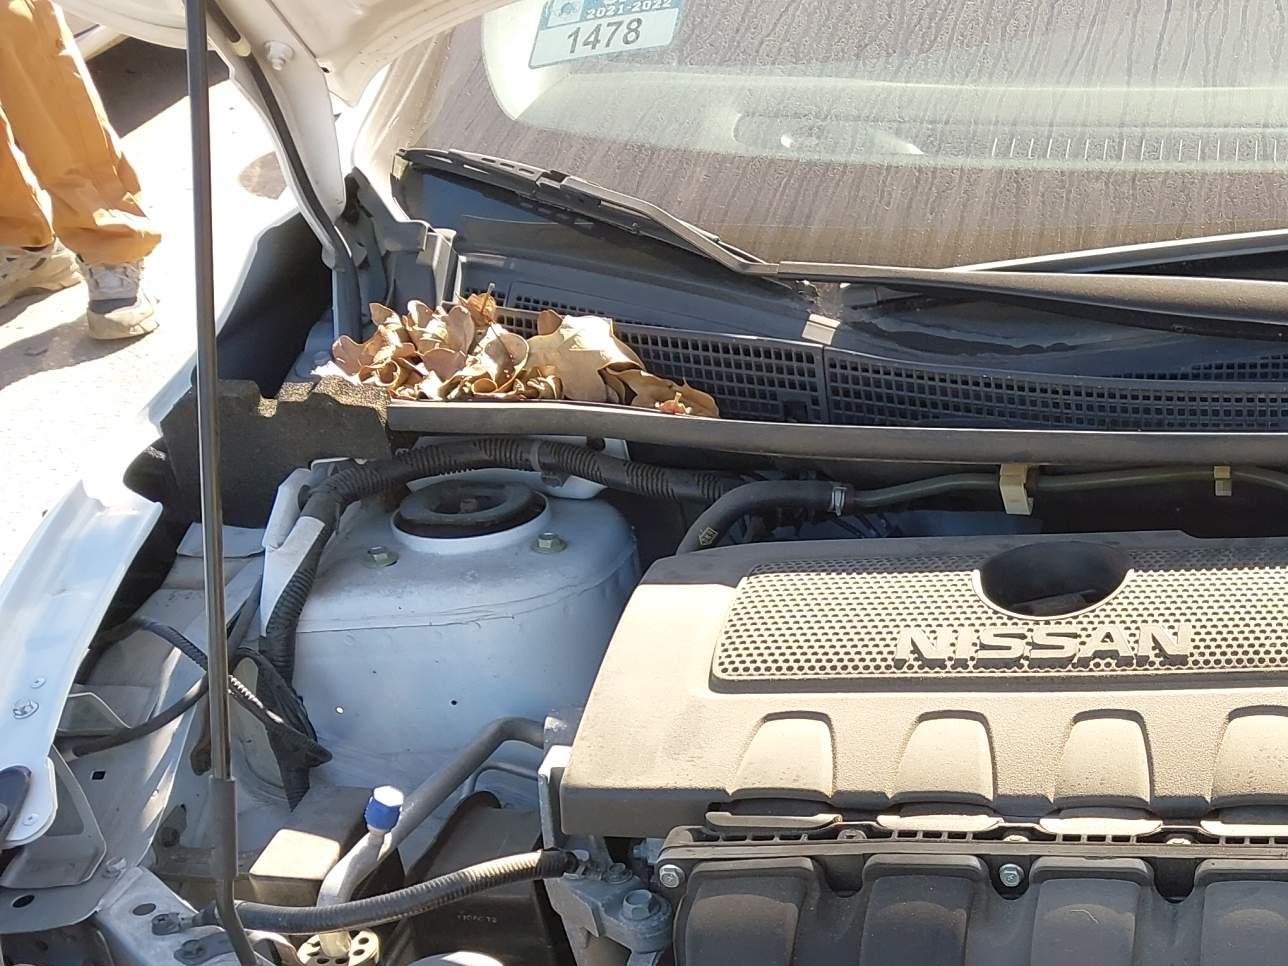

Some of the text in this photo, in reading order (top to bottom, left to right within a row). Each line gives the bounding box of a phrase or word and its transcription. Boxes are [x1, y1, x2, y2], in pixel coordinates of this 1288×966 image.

[586, 0, 672, 18] 2021-2022
[567, 17, 643, 54] 1478
[893, 623, 1193, 668] NISSAN
